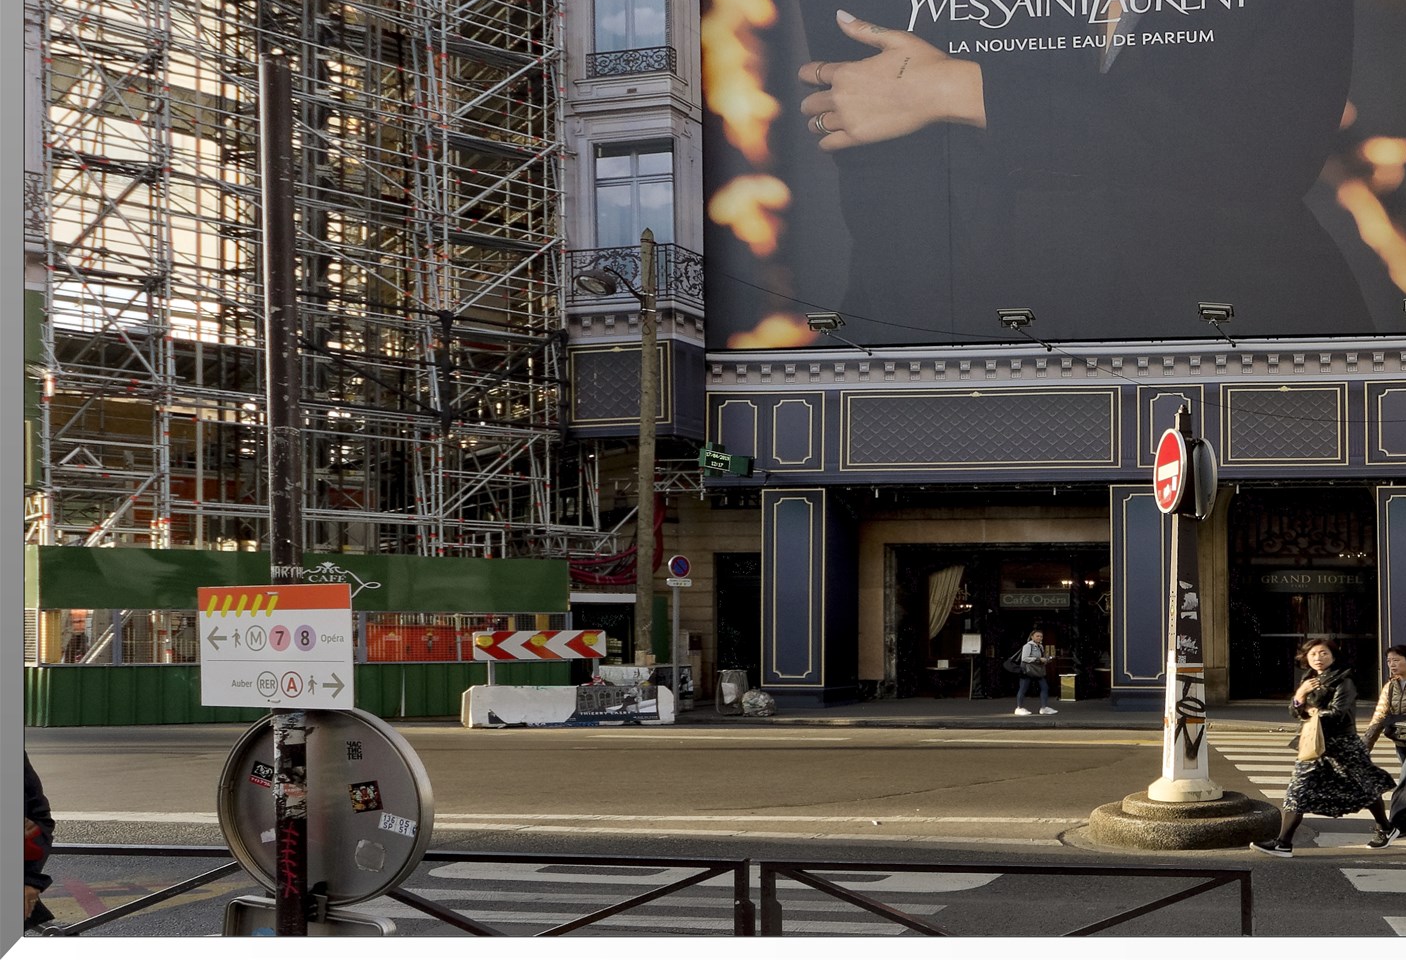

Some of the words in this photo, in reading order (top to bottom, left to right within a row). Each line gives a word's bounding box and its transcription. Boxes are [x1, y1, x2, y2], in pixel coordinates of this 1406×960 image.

[949, 41, 971, 54] LA
[976, 36, 1067, 52] NOUVELLE
[1072, 34, 1107, 49] EAU
[1113, 32, 1137, 47] DE
[1142, 29, 1215, 45] PARFUM
[1261, 575, 1311, 584] GRAND
[1318, 574, 1363, 584] HOTEL
[1003, 594, 1029, 605] Café
[1032, 594, 1067, 606] Opéra
[250, 631, 262, 645] M
[275, 631, 285, 646] 7
[300, 631, 309, 646] 8
[321, 634, 344, 644] Opéra
[232, 679, 252, 688] Auber
[260, 680, 275, 689] RER
[286, 677, 298, 692] A
